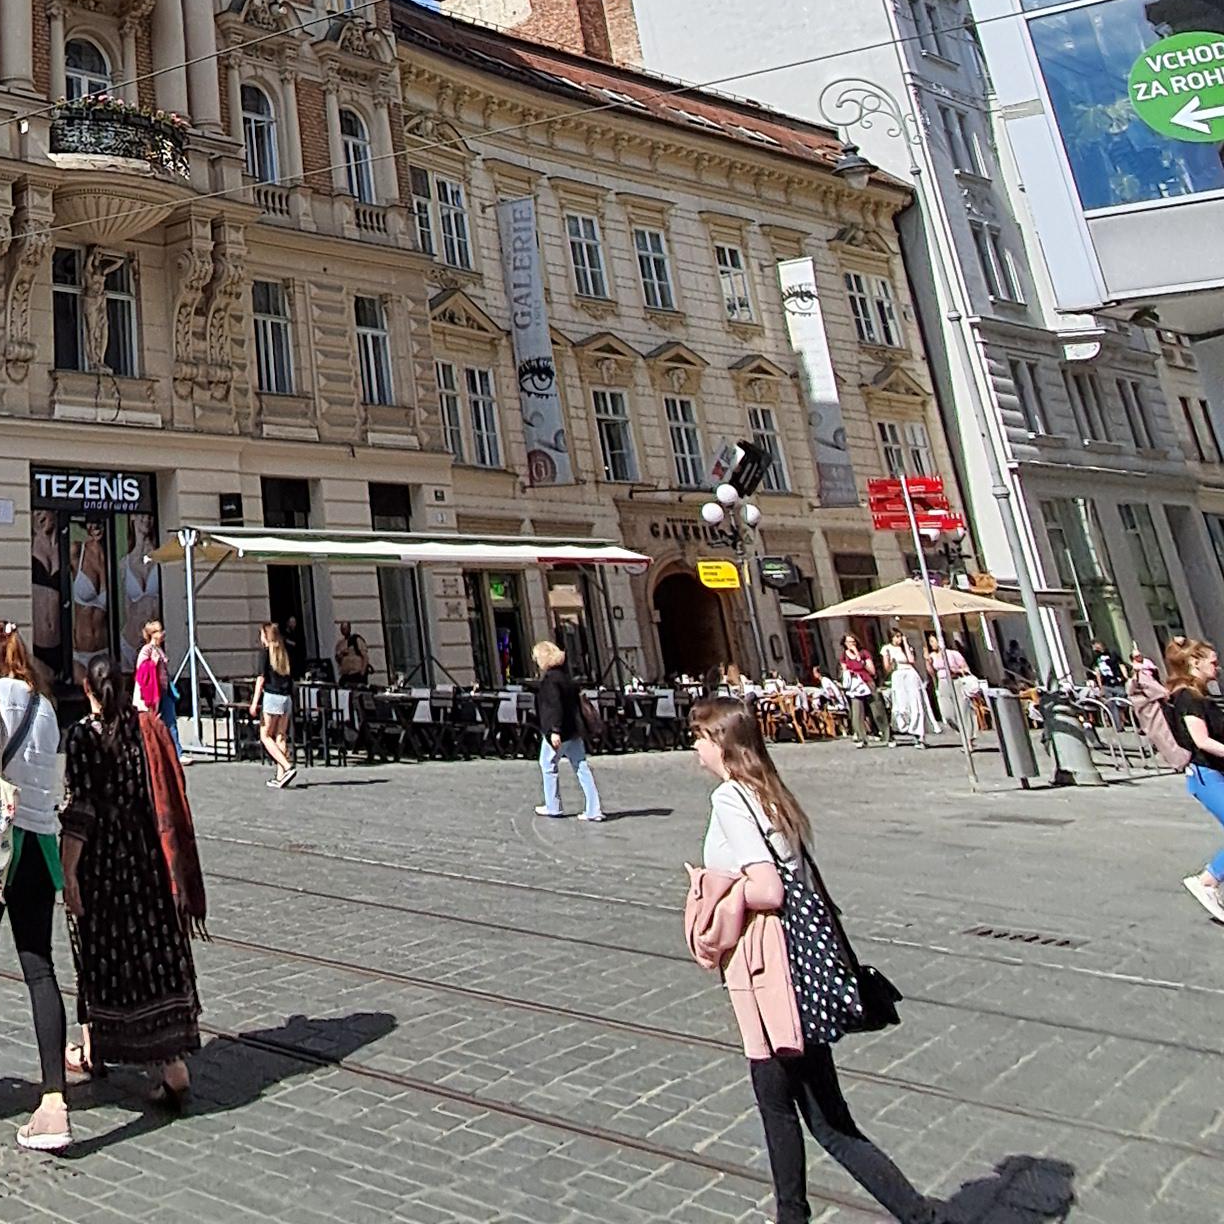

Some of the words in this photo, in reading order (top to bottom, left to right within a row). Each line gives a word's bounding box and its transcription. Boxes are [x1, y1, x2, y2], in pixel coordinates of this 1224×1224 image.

[1145, 41, 1224, 73] VCHOD
[1132, 80, 1169, 101] ZA
[1170, 66, 1224, 94] ROH
[512, 206, 533, 329] GALERIE
[83, 501, 139, 511] underwear
